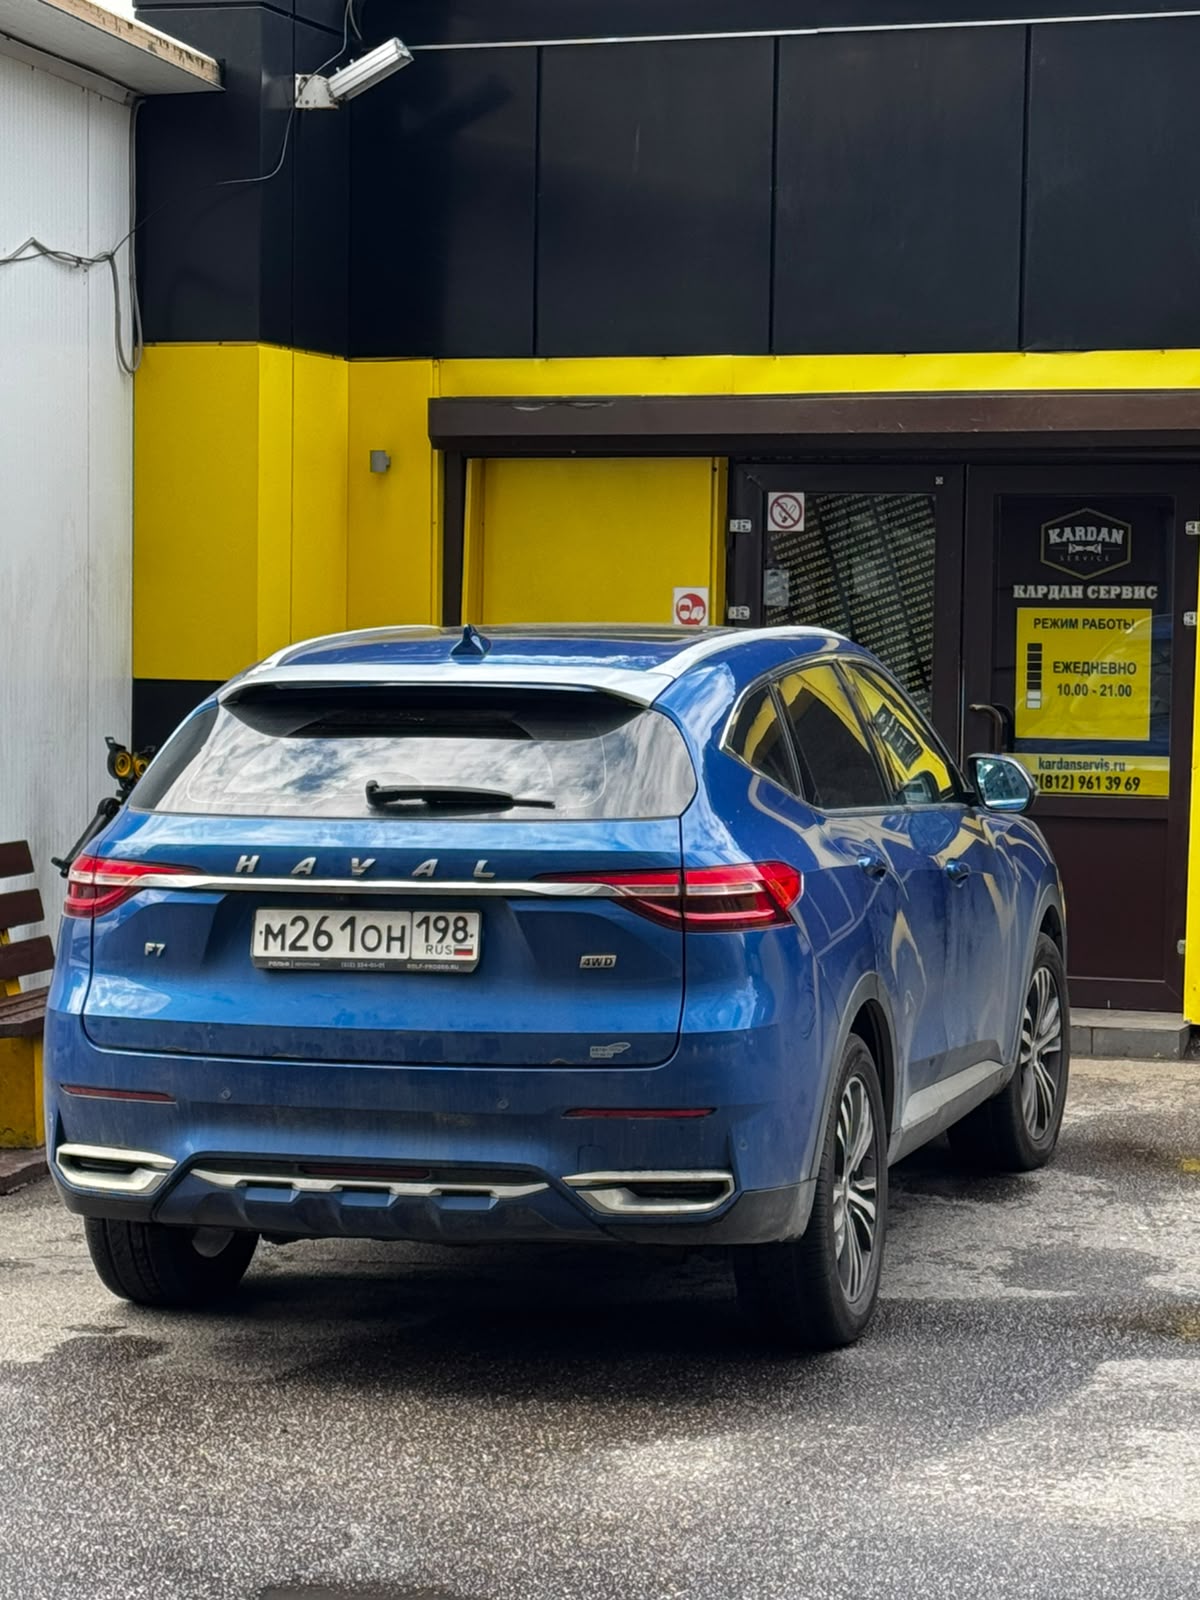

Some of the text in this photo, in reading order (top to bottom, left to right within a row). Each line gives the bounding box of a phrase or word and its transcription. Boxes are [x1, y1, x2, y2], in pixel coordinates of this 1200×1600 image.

[1048, 526, 1124, 545] KARDAN
[1013, 585, 1158, 600] КАРДАН СЕРВИС
[1033, 618, 1135, 630] РЕЖИМ РАБОТЫ
[1053, 661, 1137, 676] ЕЖЕДНЕВНО
[1057, 683, 1088, 697] 10.00
[1100, 684, 1132, 697] 21.00
[1038, 756, 1126, 772] kardanservis.ru
[1078, 775, 1101, 790] 961
[1105, 776, 1120, 790] 39
[1124, 777, 1141, 791] 69
[235, 855, 495, 878] HAVAL
[415, 915, 469, 944] 198
[144, 942, 166, 957] F7
[425, 944, 453, 956] RUS
[583, 957, 613, 967] 4WD
